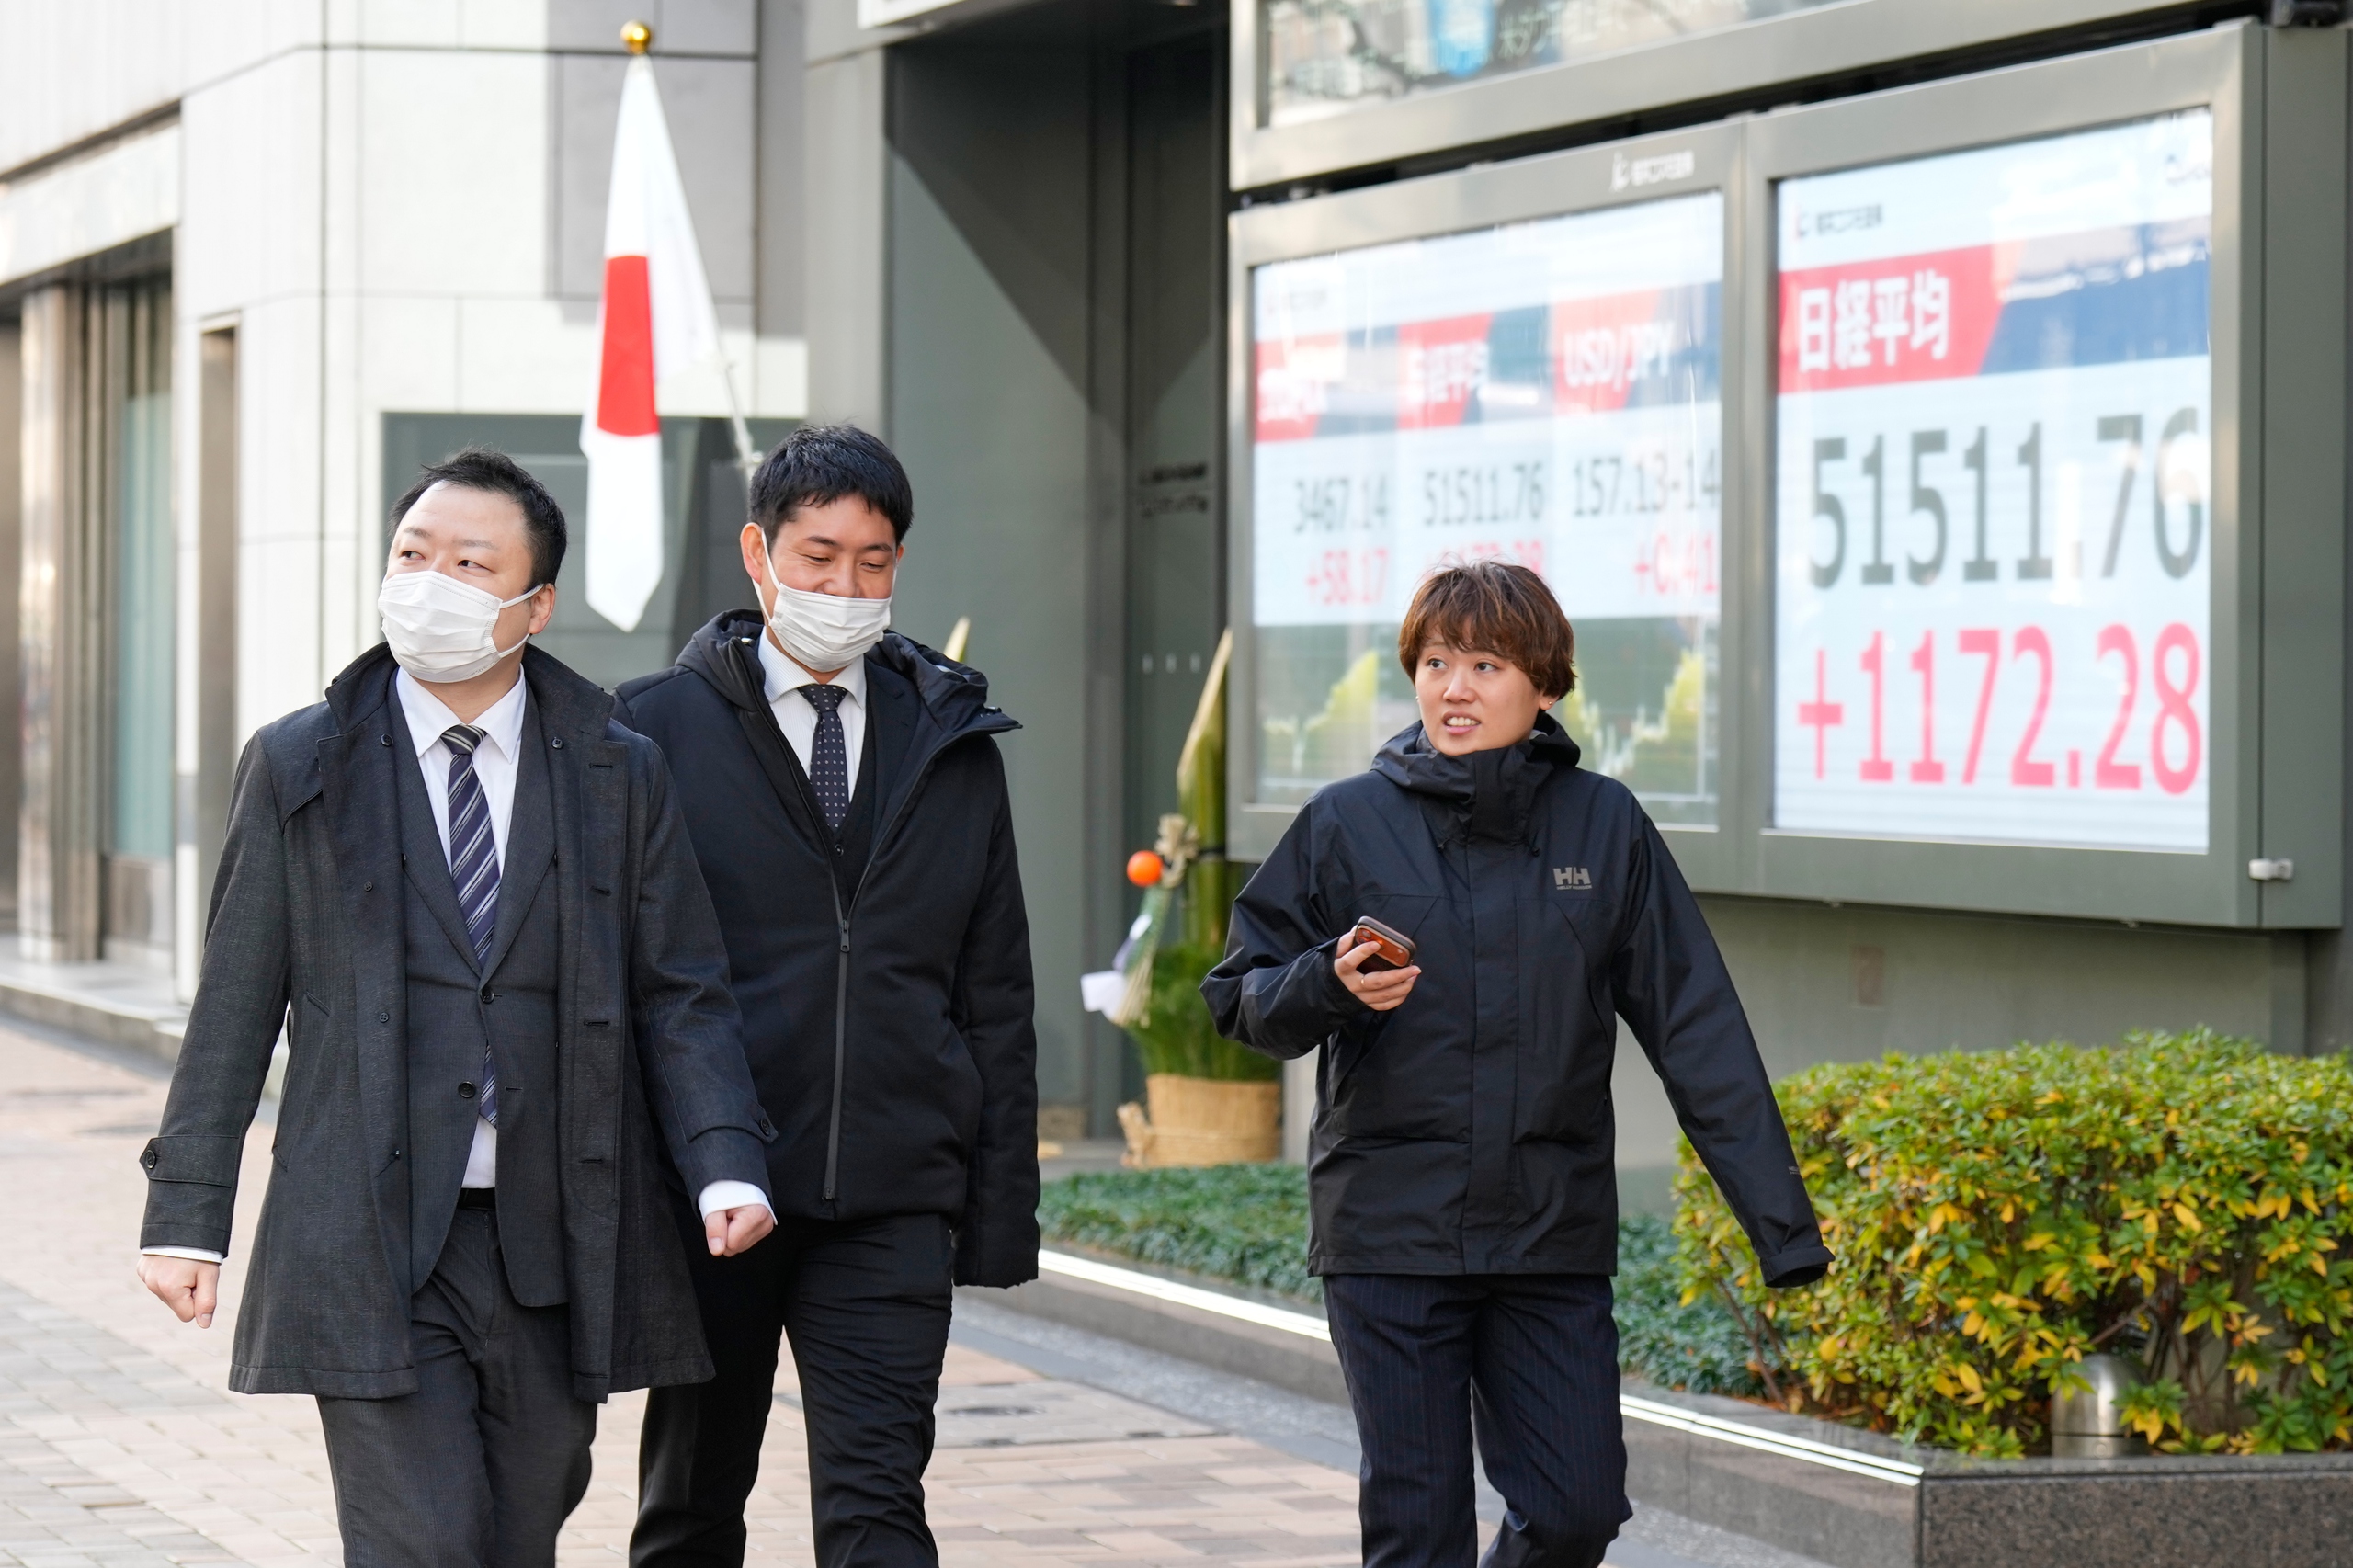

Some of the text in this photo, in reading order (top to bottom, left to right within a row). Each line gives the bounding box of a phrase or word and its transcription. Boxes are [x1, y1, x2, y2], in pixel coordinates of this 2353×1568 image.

[1563, 321, 1675, 393] USD/JPY
[1798, 268, 1950, 373] 日経平均
[1424, 461, 1545, 527] 51511.76
[1807, 406, 2204, 591] 51511.76
[1797, 621, 2202, 794] +1172.28
[1553, 866, 1592, 885] HH
